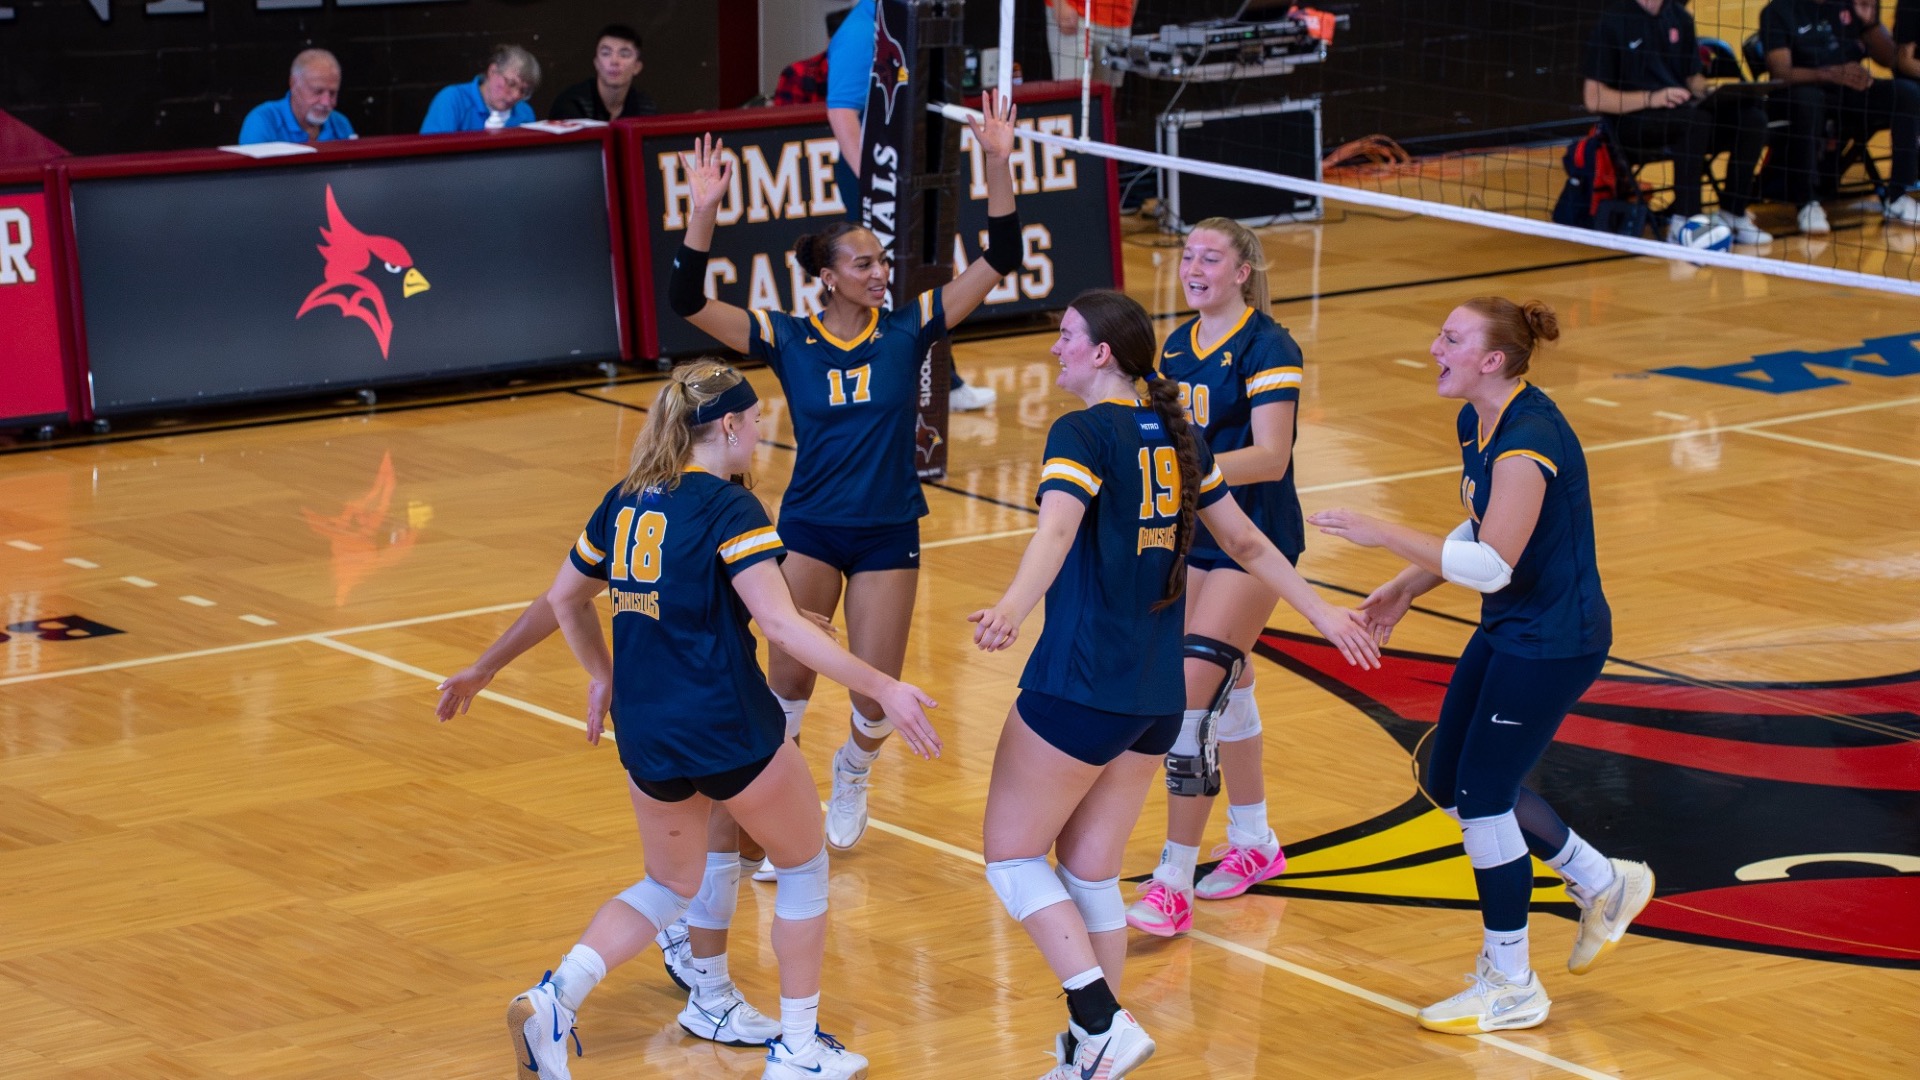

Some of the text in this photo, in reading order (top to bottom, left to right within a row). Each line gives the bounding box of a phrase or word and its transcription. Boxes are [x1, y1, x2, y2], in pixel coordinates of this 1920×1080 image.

[959, 114, 1078, 200] THE
[827, 363, 871, 406] 17
[1177, 381, 1209, 428] 20
[1138, 446, 1182, 520] 19
[611, 506, 667, 583] 18
